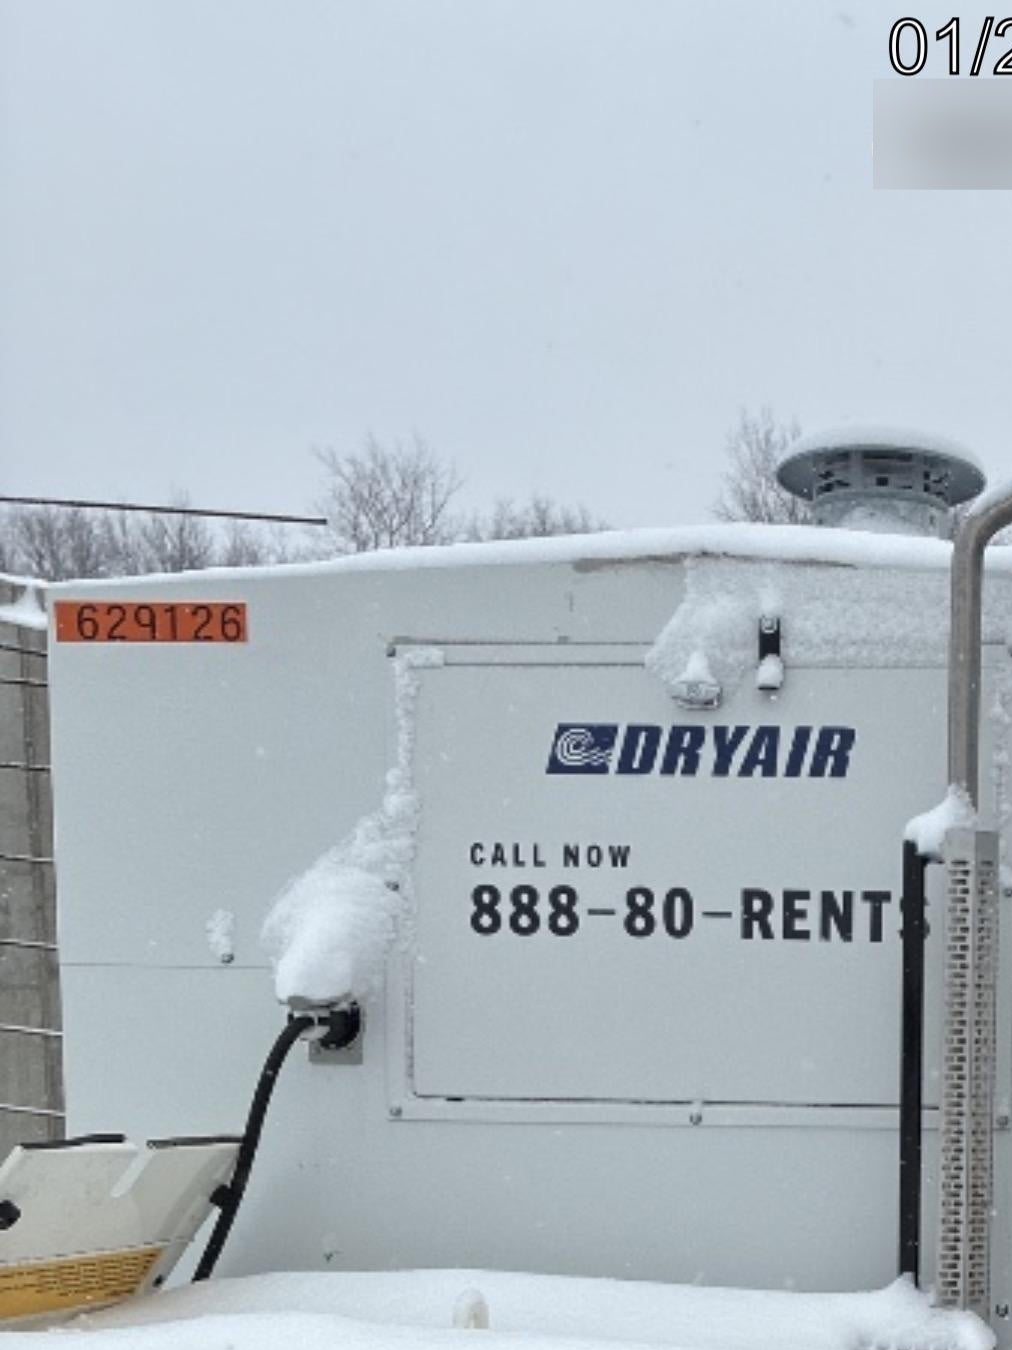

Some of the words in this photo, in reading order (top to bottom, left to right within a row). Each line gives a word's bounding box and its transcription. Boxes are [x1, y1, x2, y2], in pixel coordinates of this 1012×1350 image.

[76, 604, 242, 642] 629126
[614, 724, 856, 778] DRYAIR
[470, 842, 546, 868] CALL
[563, 845, 631, 868] NOW
